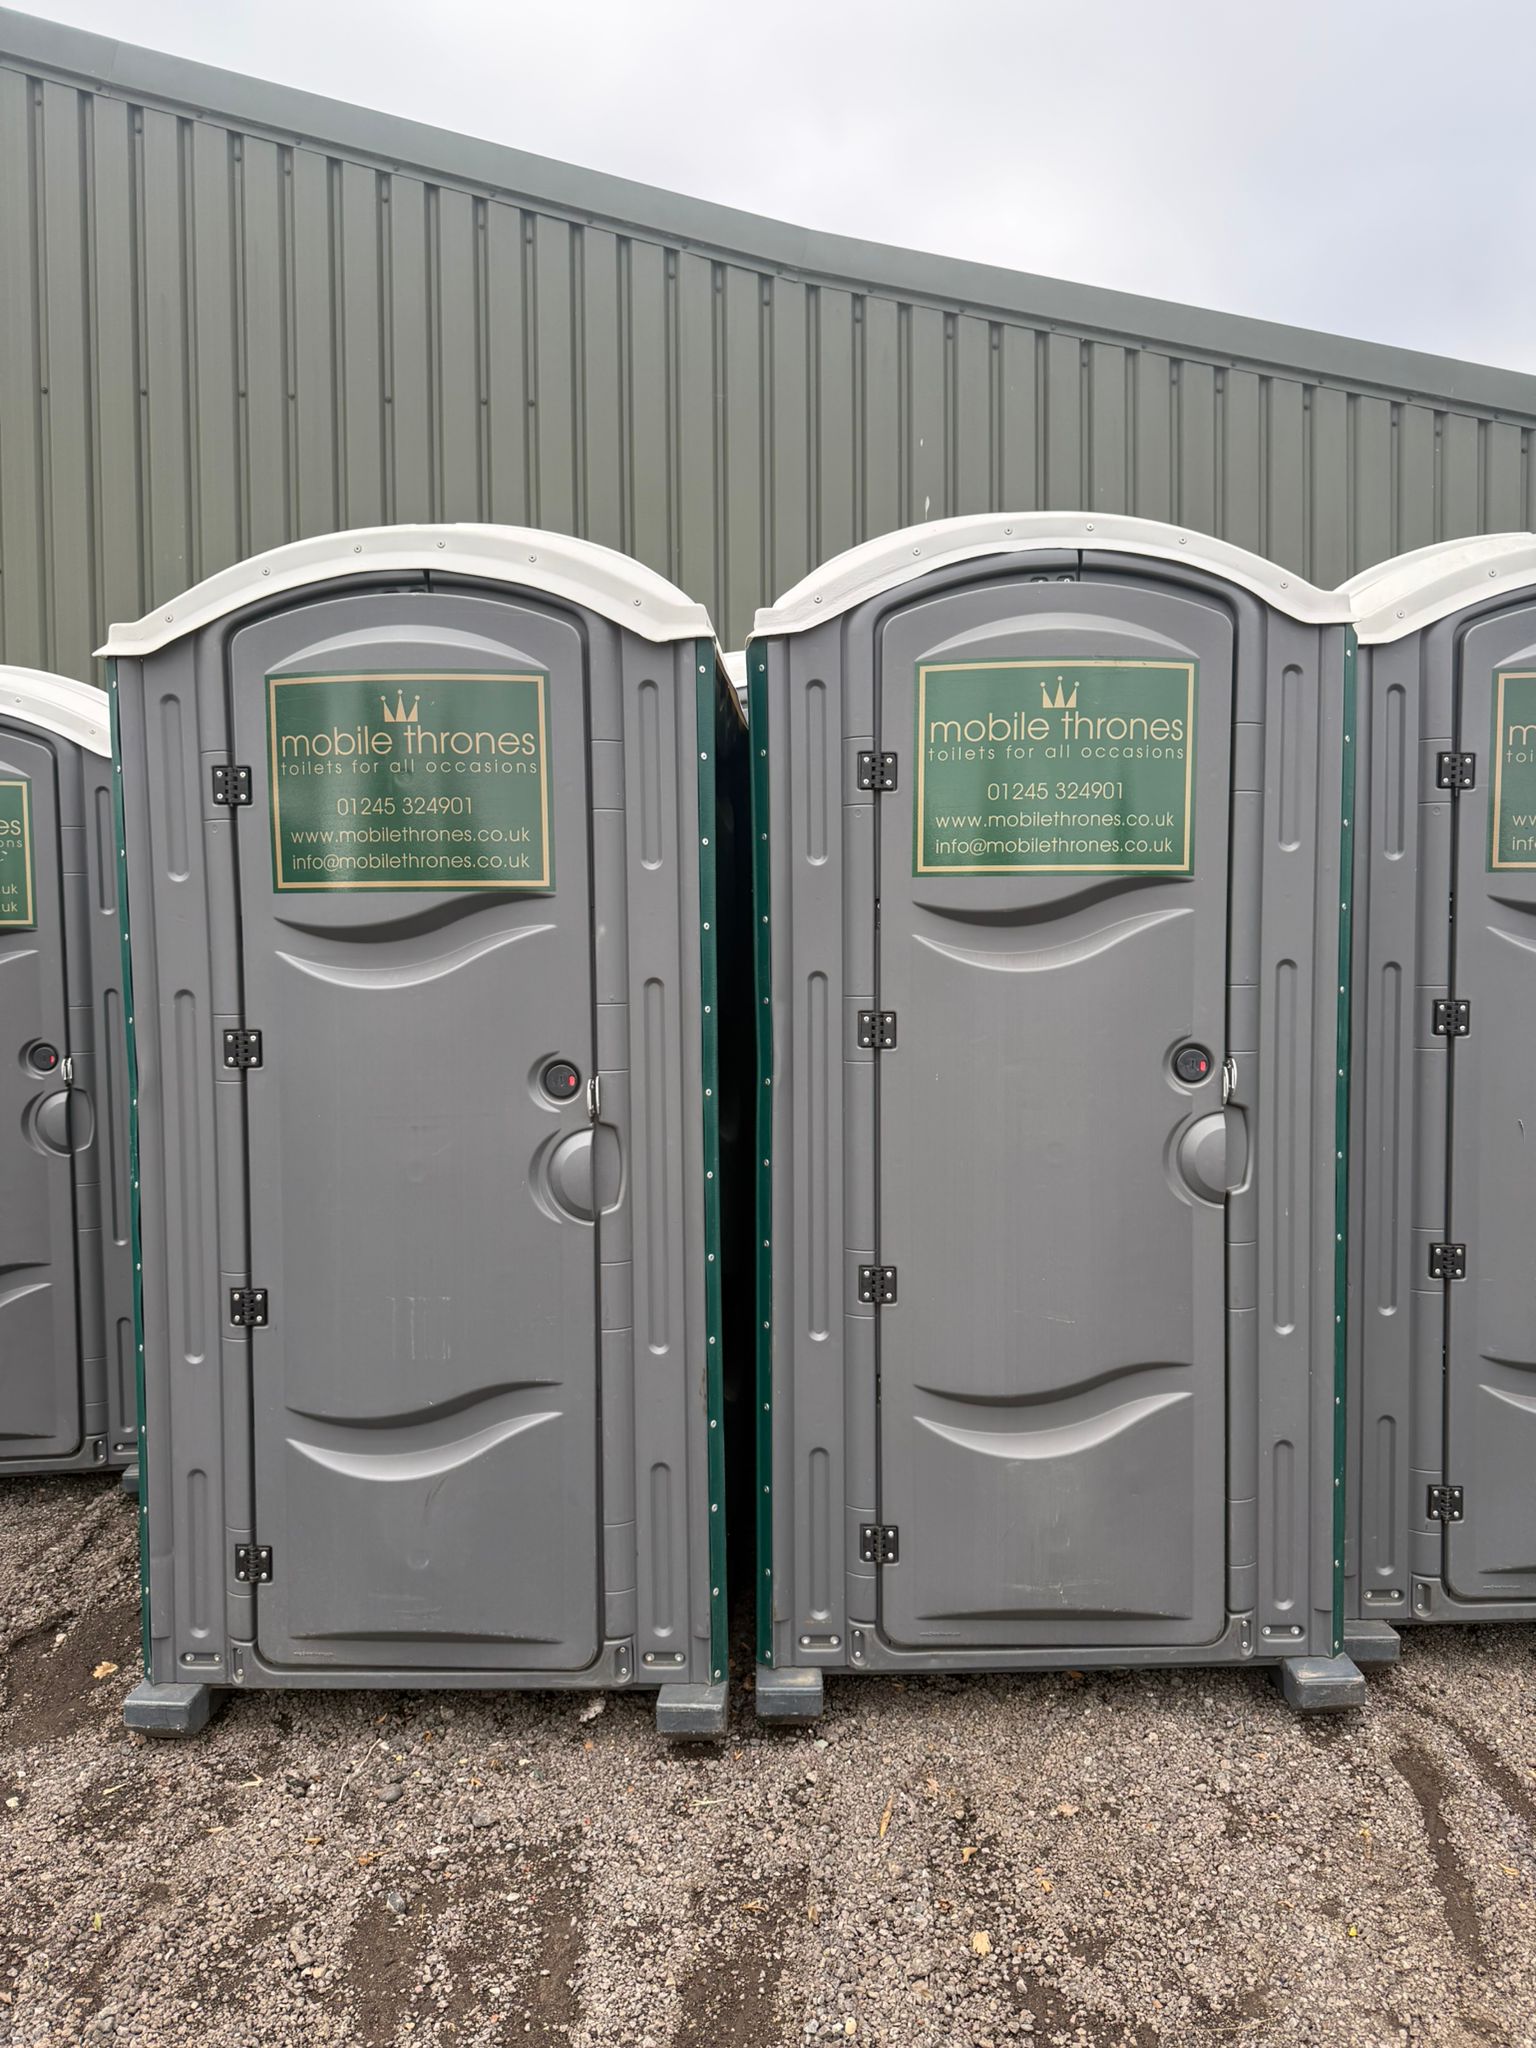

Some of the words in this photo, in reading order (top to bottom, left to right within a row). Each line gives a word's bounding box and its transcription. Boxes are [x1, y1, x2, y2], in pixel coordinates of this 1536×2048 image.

[930, 711, 1050, 743] mobile
[1061, 711, 1184, 741] thrones
[281, 726, 393, 757] mobile
[403, 725, 536, 755] thrones
[928, 746, 995, 761] toilets
[1006, 745, 1034, 759] for
[1045, 744, 1070, 759] all
[1081, 744, 1184, 760] occasions
[281, 760, 342, 776] toilets
[352, 759, 379, 774] for
[389, 759, 415, 773] all
[425, 758, 537, 774] occasions
[987, 783, 1049, 801] 01245
[1055, 782, 1123, 800] 324901
[337, 798, 396, 816] 01245
[402, 797, 472, 815] 324901
[935, 811, 1174, 828] www.mobilethrones.co.uk
[290, 826, 530, 844] www.mobilethrones.co.uk
[1512, 836, 1536, 851] inf
[935, 837, 1173, 856] info@mobilethrones.co.uk
[292, 852, 530, 872] info@mobilethrones.co.uk
